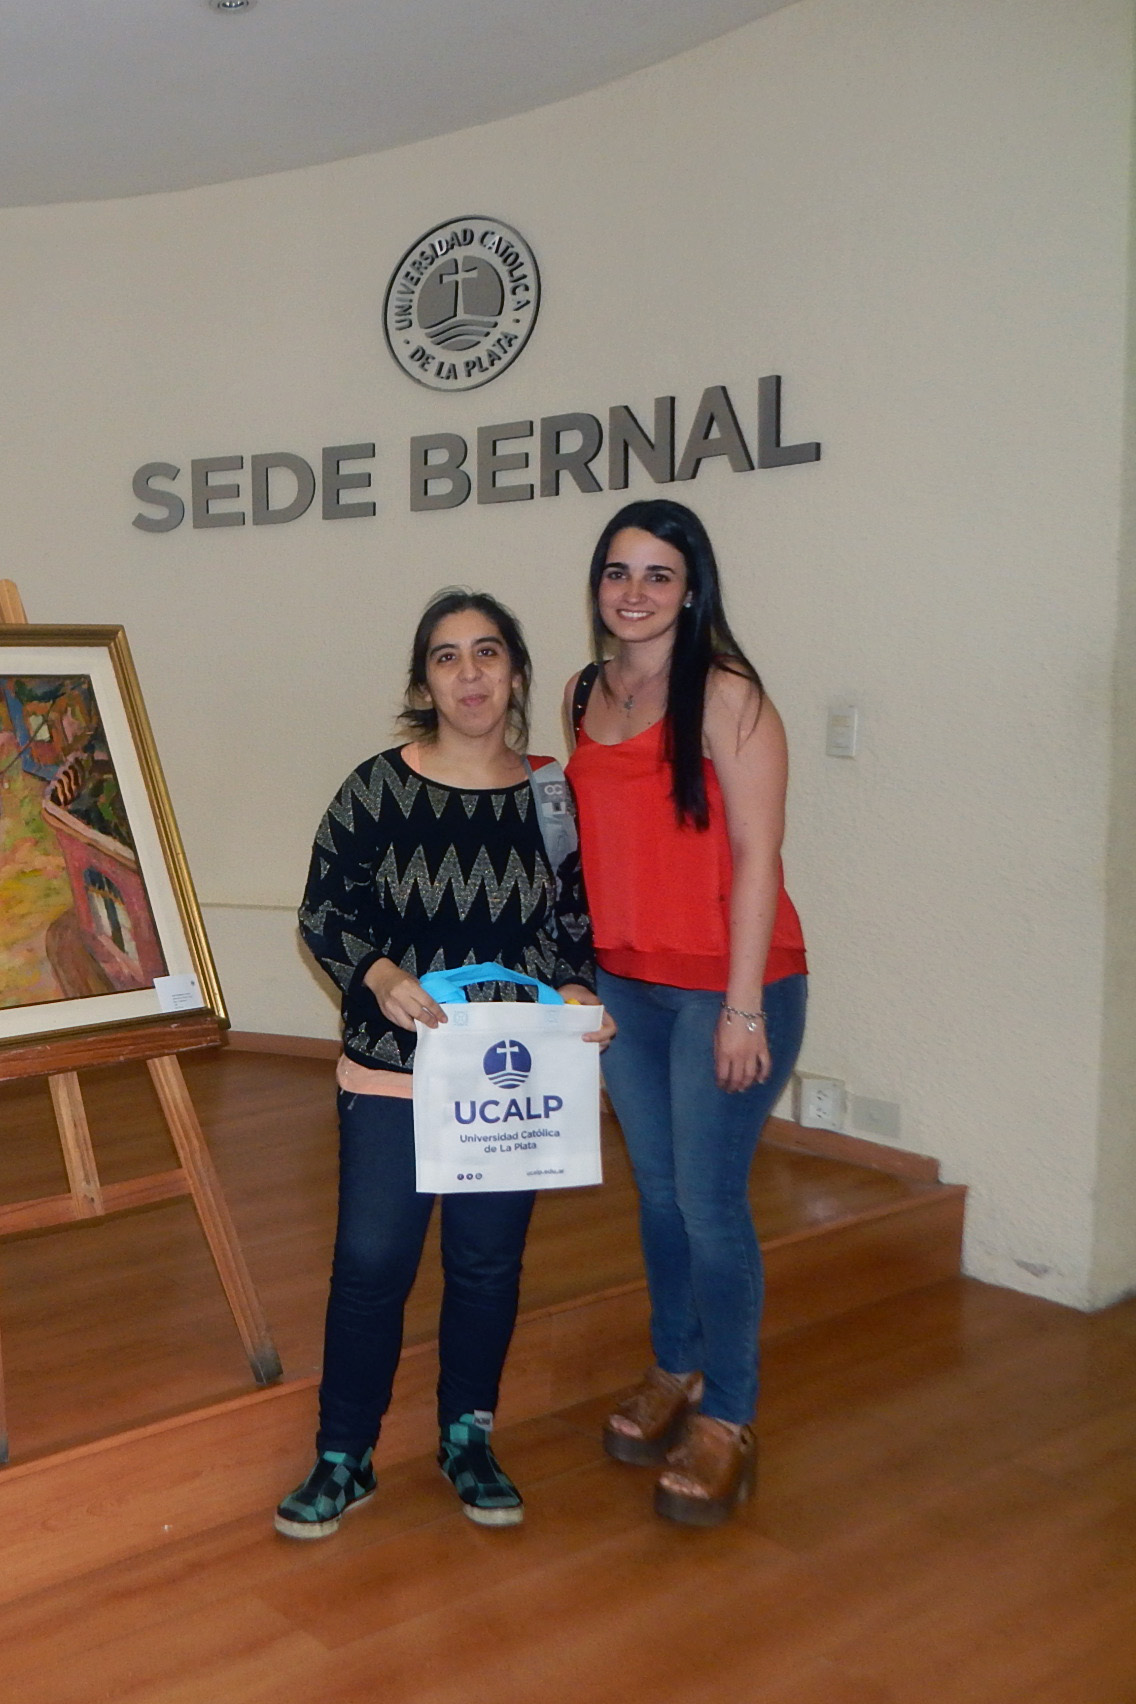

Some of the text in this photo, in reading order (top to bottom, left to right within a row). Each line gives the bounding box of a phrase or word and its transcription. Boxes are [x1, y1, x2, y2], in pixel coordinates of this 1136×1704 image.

[394, 228, 532, 331] UNIVERSIDAD CATOLICA
[408, 331, 519, 380] DE LA PLATA
[131, 374, 822, 533] SEDE BERNAL
[454, 1095, 564, 1125] UCALP
[460, 1129, 561, 1143] Universidad Católica
[484, 1142, 537, 1153] de La Plata
